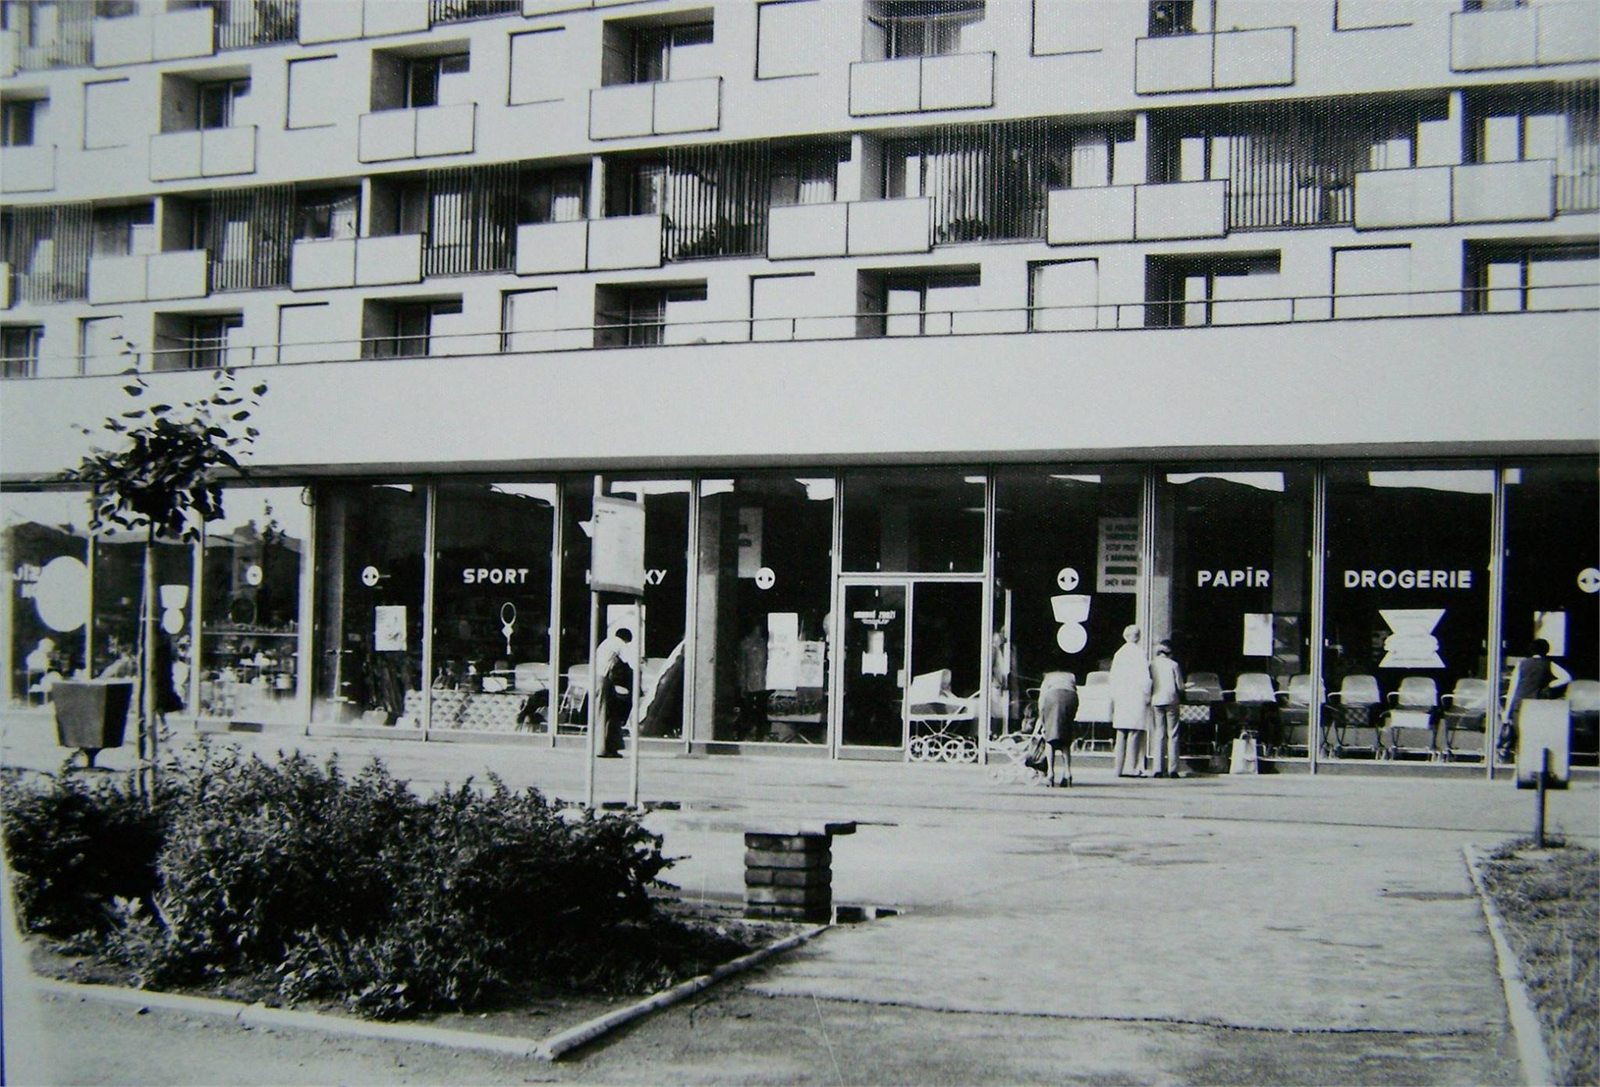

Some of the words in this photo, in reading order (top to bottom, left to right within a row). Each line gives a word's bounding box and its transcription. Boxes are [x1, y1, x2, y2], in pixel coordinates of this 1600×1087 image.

[463, 568, 529, 584] SPORT
[1197, 566, 1270, 588] PAPÍR
[1344, 569, 1472, 589] DROGERIE
